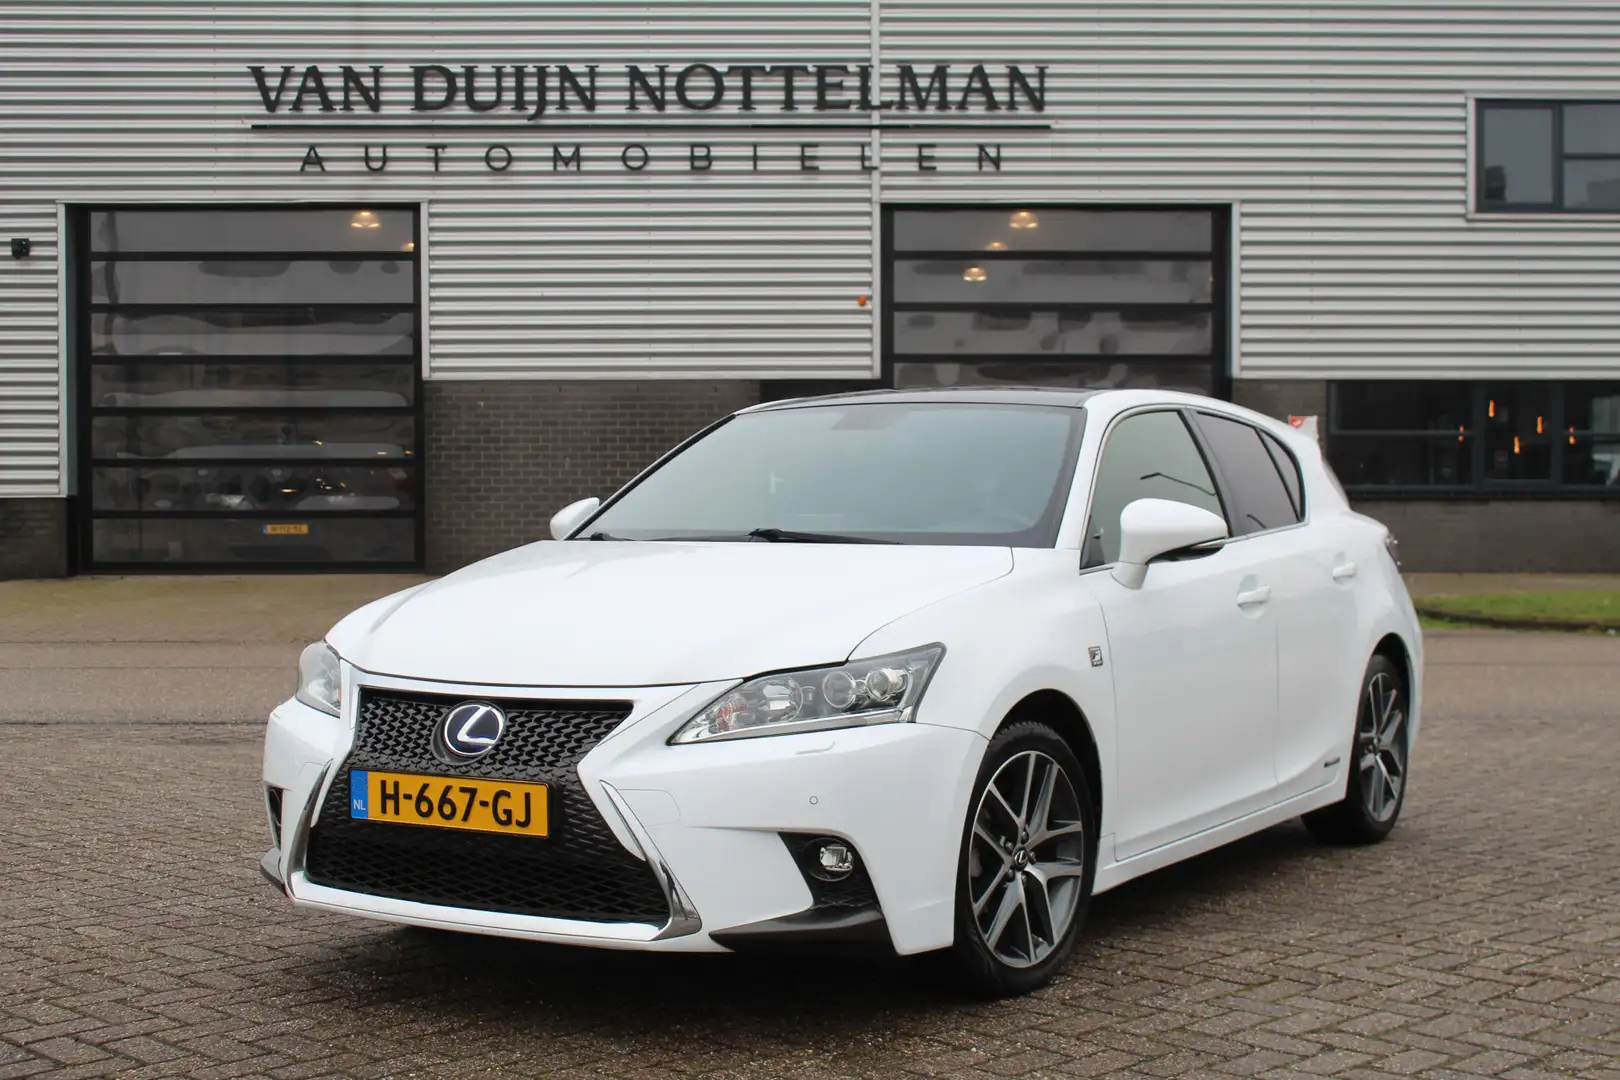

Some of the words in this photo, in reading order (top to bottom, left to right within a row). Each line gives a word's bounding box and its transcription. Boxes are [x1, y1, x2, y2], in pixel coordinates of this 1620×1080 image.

[247, 65, 384, 113] VAN
[410, 65, 599, 121] DUIJN
[625, 64, 1049, 112] NOTTELMAN
[300, 145, 1001, 172] AUTOMOBIELEN
[353, 799, 366, 811] NL
[380, 779, 532, 829] H-667-GJ
